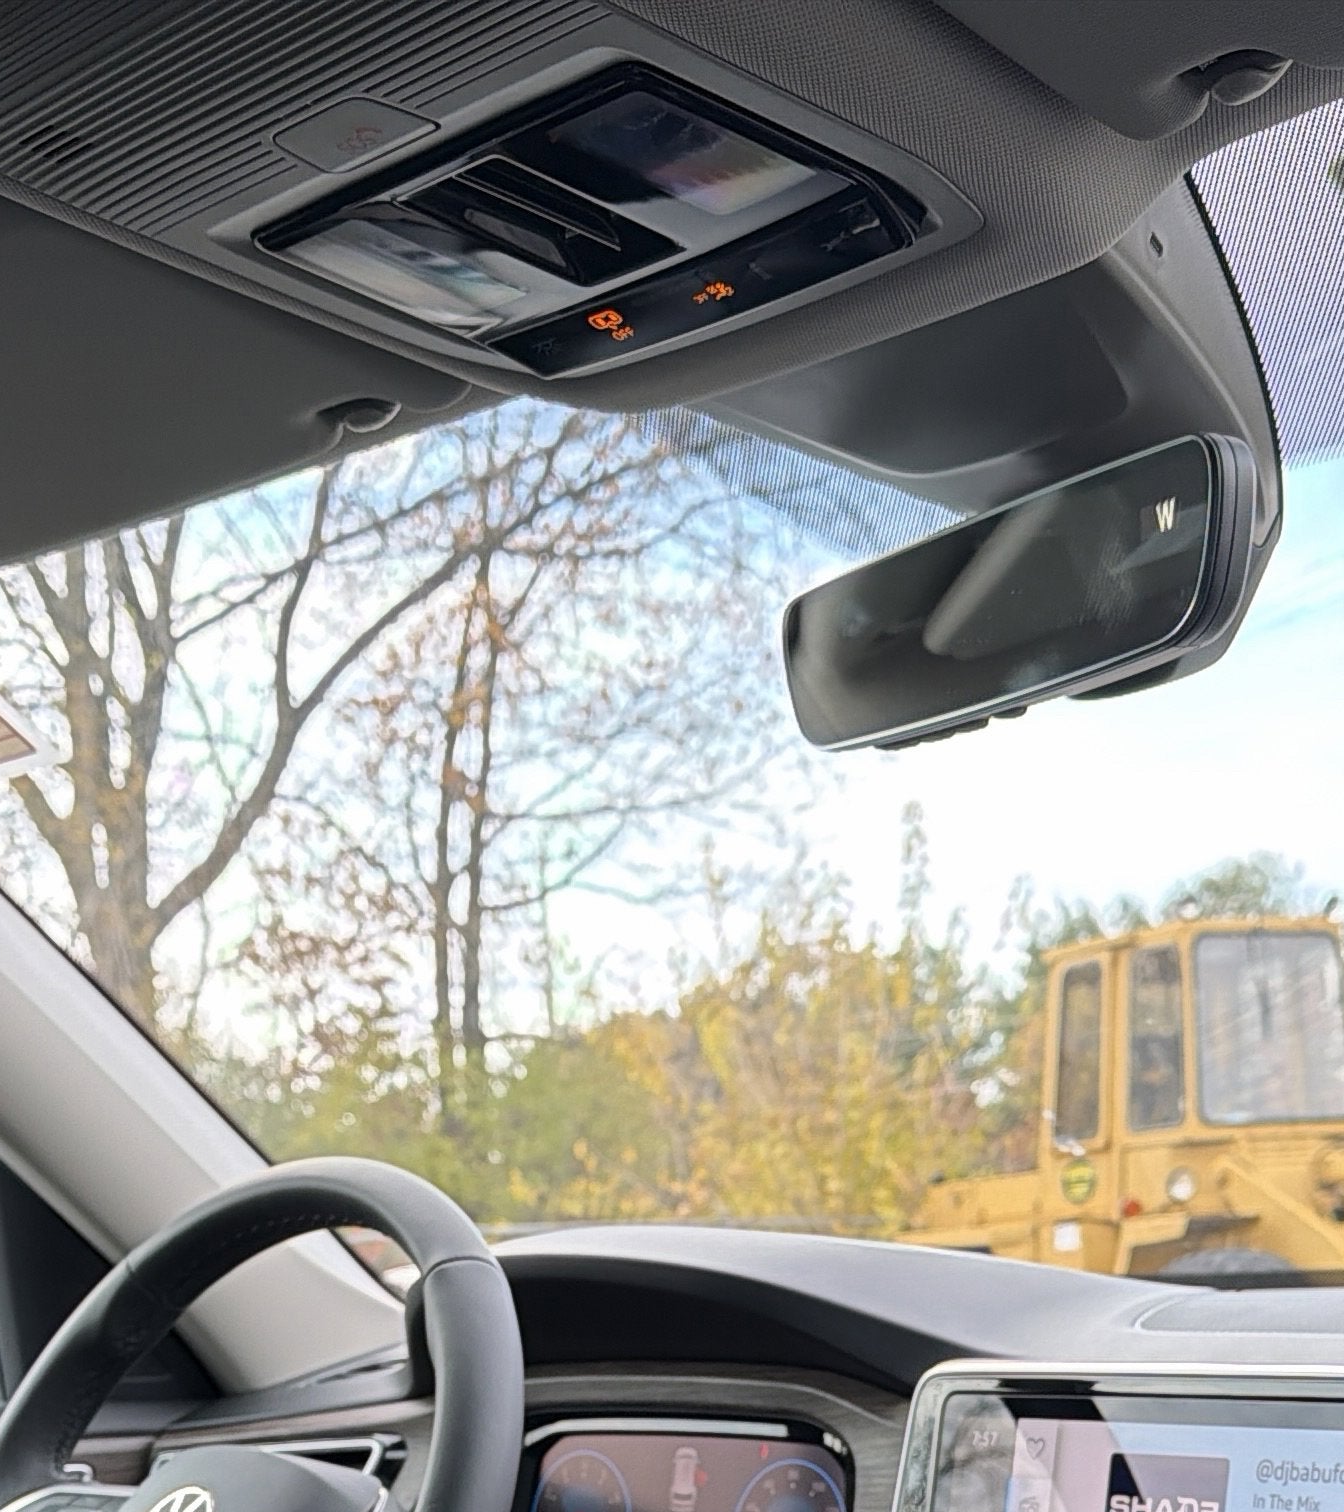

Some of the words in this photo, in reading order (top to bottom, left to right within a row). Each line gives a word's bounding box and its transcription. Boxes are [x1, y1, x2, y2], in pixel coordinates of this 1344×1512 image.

[1155, 496, 1176, 533] W
[1252, 1494, 1265, 1509] In
[1268, 1494, 1293, 1511] The
[1296, 1496, 1321, 1512] Mix
